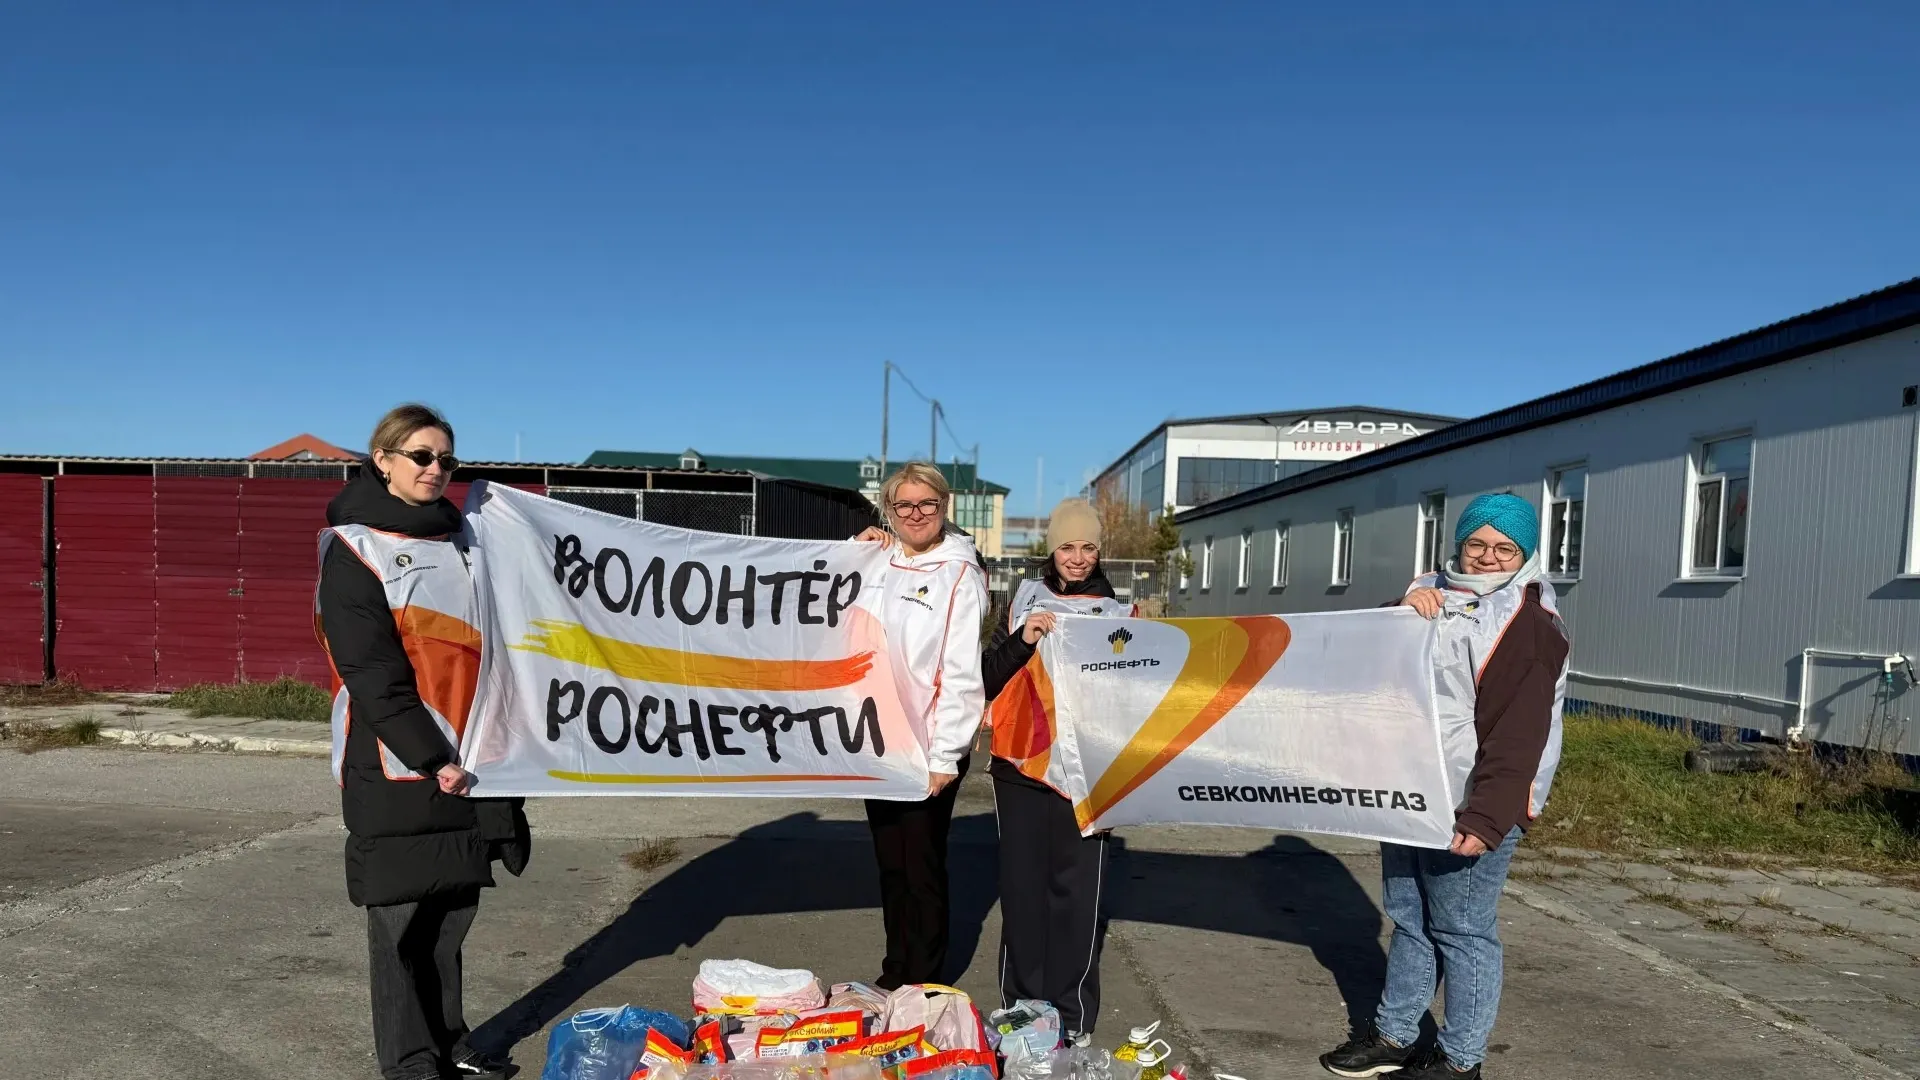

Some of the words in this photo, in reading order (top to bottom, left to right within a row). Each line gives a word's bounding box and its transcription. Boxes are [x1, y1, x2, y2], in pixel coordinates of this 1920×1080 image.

[1285, 420, 1421, 436] АВРОРА
[1294, 440, 1362, 452] ТОРГОВЫЙ
[554, 534, 861, 629] ВОЛОНТЁР
[1081, 658, 1160, 672] РОСНЕФТЬ
[547, 678, 885, 763] РОСНЕФТИ
[1178, 785, 1427, 812] СЕВКОМНЕФТЕГАЗ
